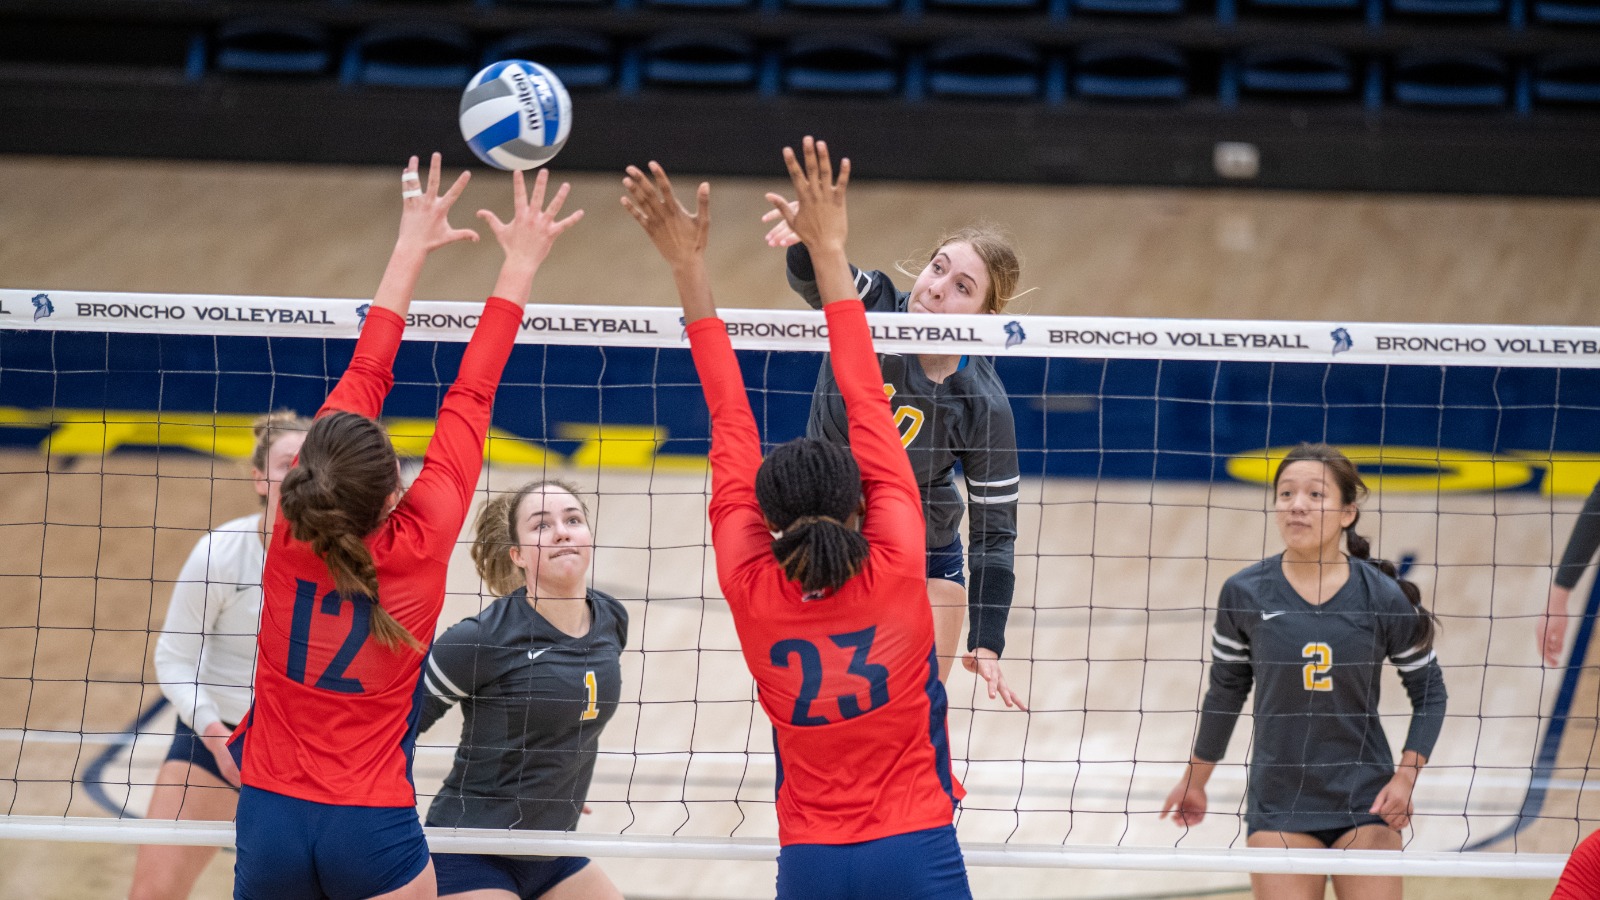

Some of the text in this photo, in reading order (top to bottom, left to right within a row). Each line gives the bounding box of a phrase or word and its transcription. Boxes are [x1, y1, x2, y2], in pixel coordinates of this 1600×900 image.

[512, 73, 541, 131] molten
[75, 302, 336, 325] BRONCHO VOLLEYBALL
[405, 313, 659, 334] BRONC VOLLEYBALL
[870, 325, 983, 342] LLEYBALL
[1047, 329, 1310, 349] BRONCHO VOLLEYBALL
[1375, 336, 1600, 354] BRONCHO VOLLEYB
[286, 577, 373, 694] 12
[769, 624, 890, 727] 23
[1302, 641, 1334, 691] 2
[580, 671, 599, 721] 1
